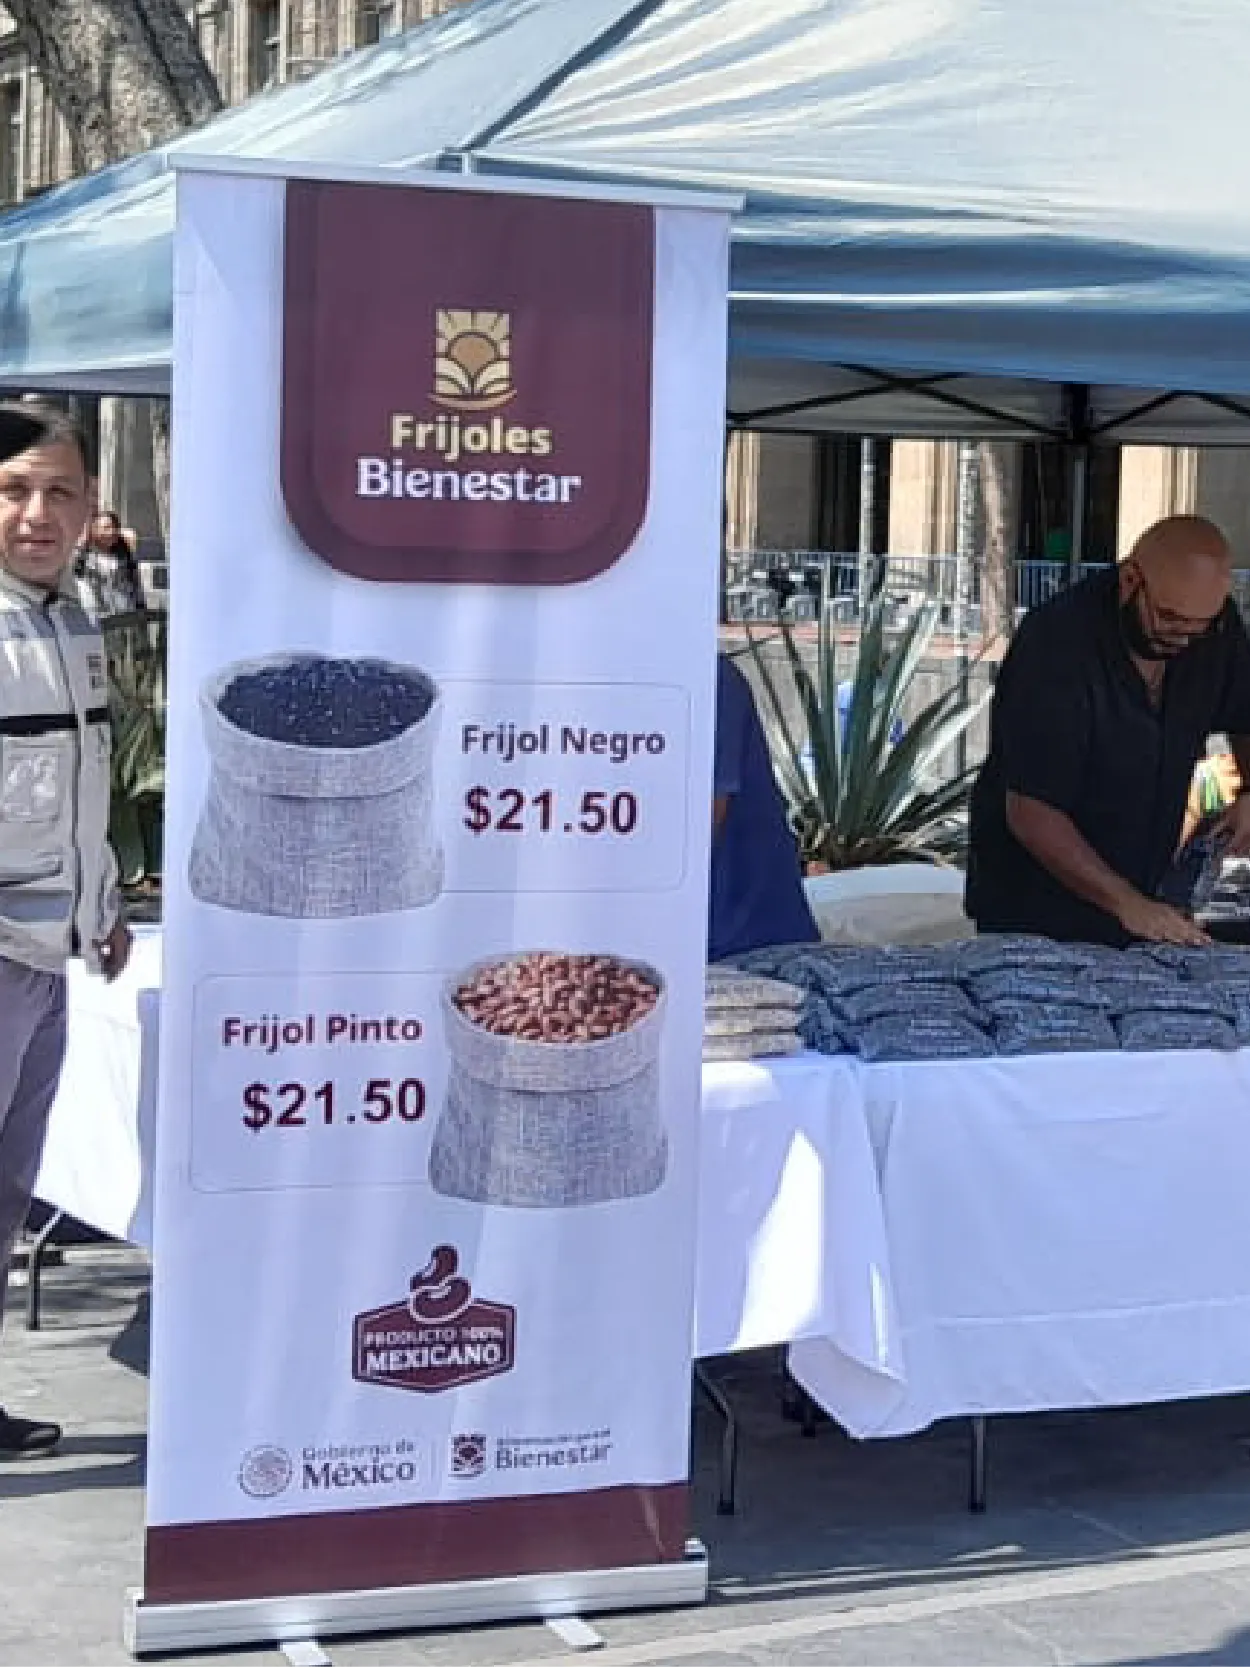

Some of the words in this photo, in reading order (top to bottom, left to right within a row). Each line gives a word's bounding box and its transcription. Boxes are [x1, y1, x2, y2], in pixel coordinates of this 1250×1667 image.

[390, 414, 553, 461] Frijoles
[355, 456, 582, 502] Bienestar
[461, 721, 549, 763] Frijol
[560, 726, 666, 763] Negro
[461, 785, 638, 838] $21.50
[222, 1013, 315, 1055] Frijol
[326, 1013, 423, 1043] Pinto
[241, 1077, 427, 1134] $21.50
[365, 1342, 502, 1372] MEXICANO
[301, 1462, 417, 1490] México
[495, 1443, 613, 1471] Bienestar
